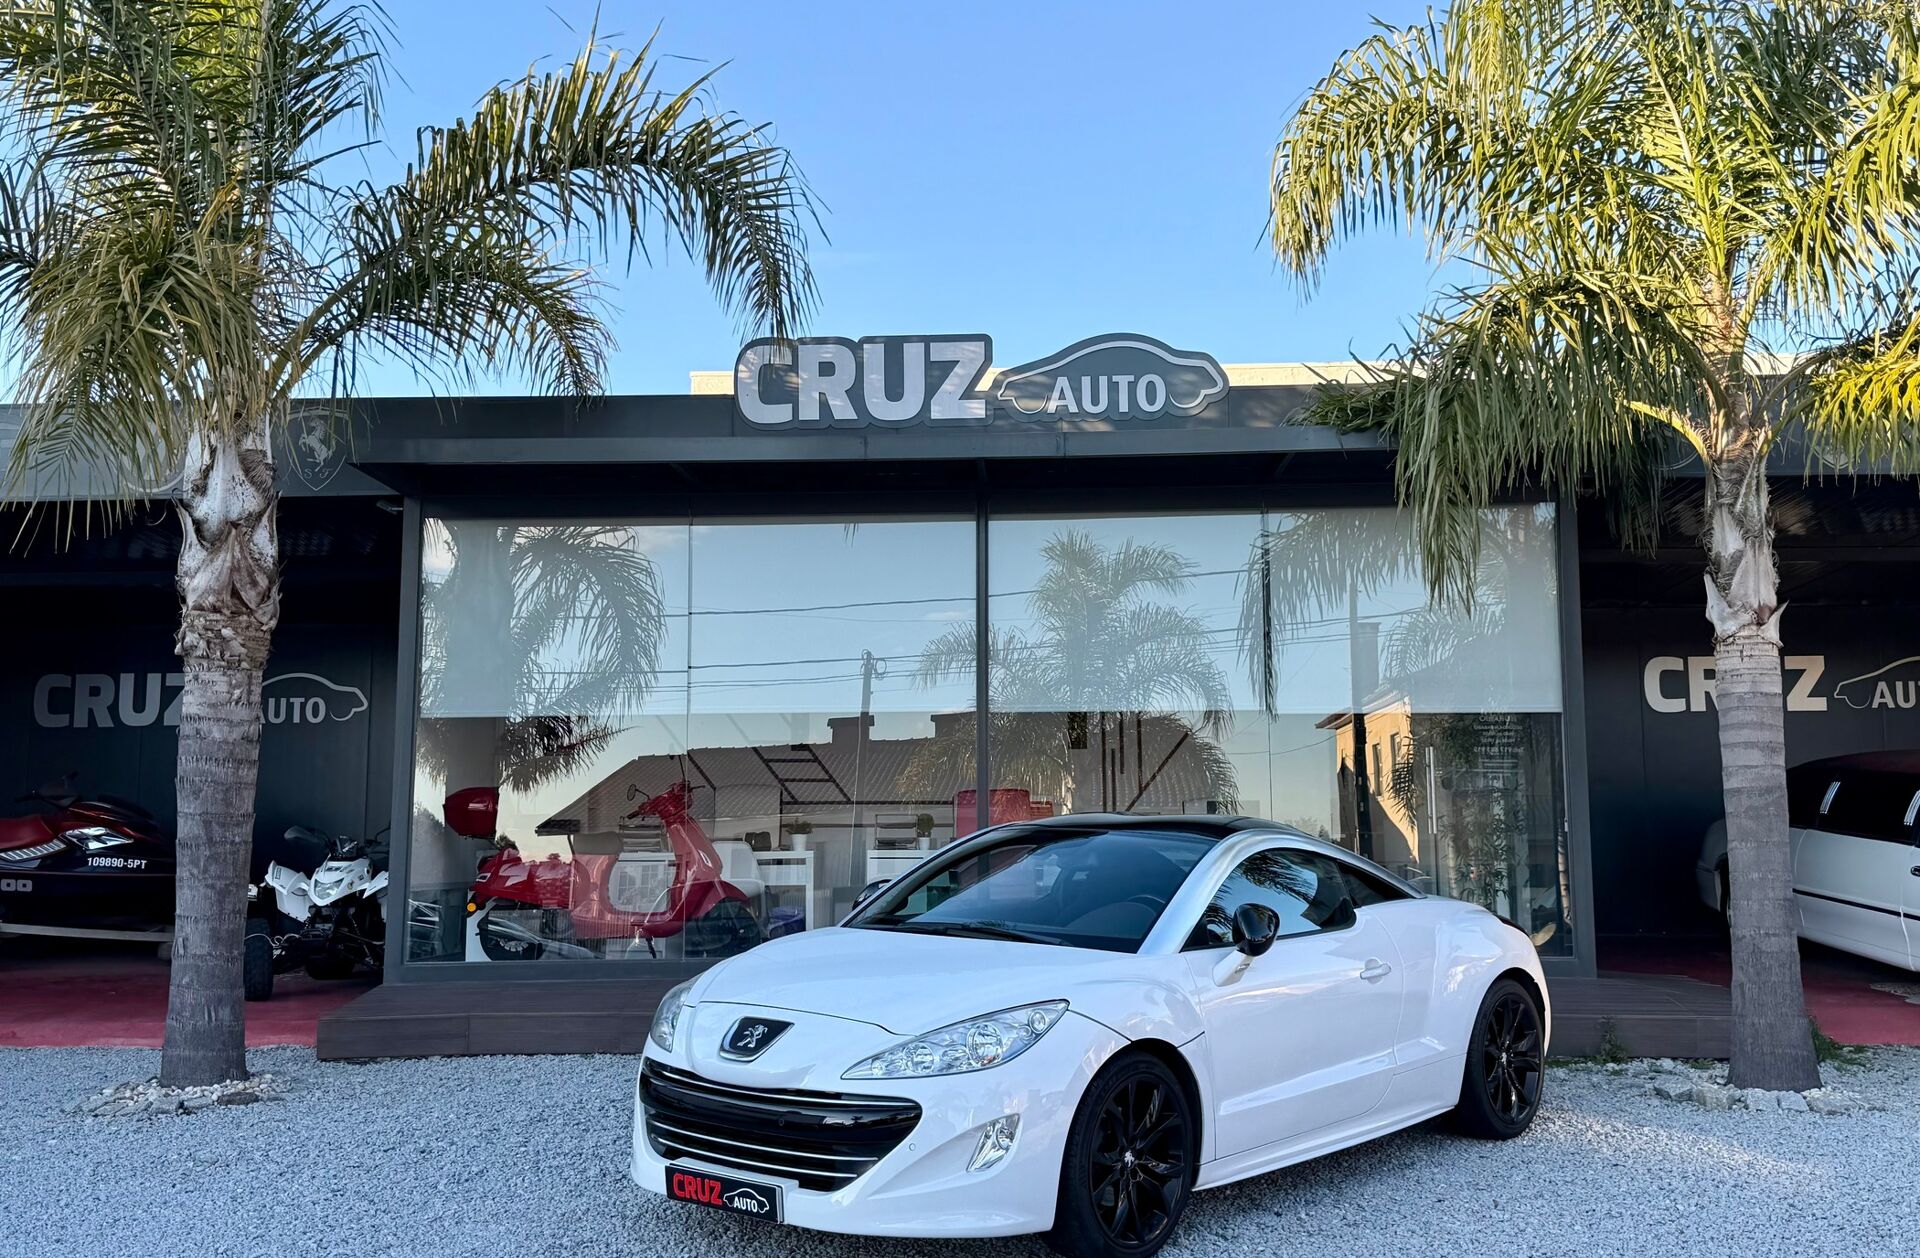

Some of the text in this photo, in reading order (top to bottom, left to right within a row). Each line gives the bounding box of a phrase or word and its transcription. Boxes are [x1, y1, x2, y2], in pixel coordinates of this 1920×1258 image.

[738, 341, 1167, 424] CRUZ AUTO
[1644, 655, 1920, 713] CRZ AU
[260, 696, 326, 724] UTO
[87, 856, 148, 869] 109890-5PT
[673, 1172, 758, 1213] CRUZ AUTO
